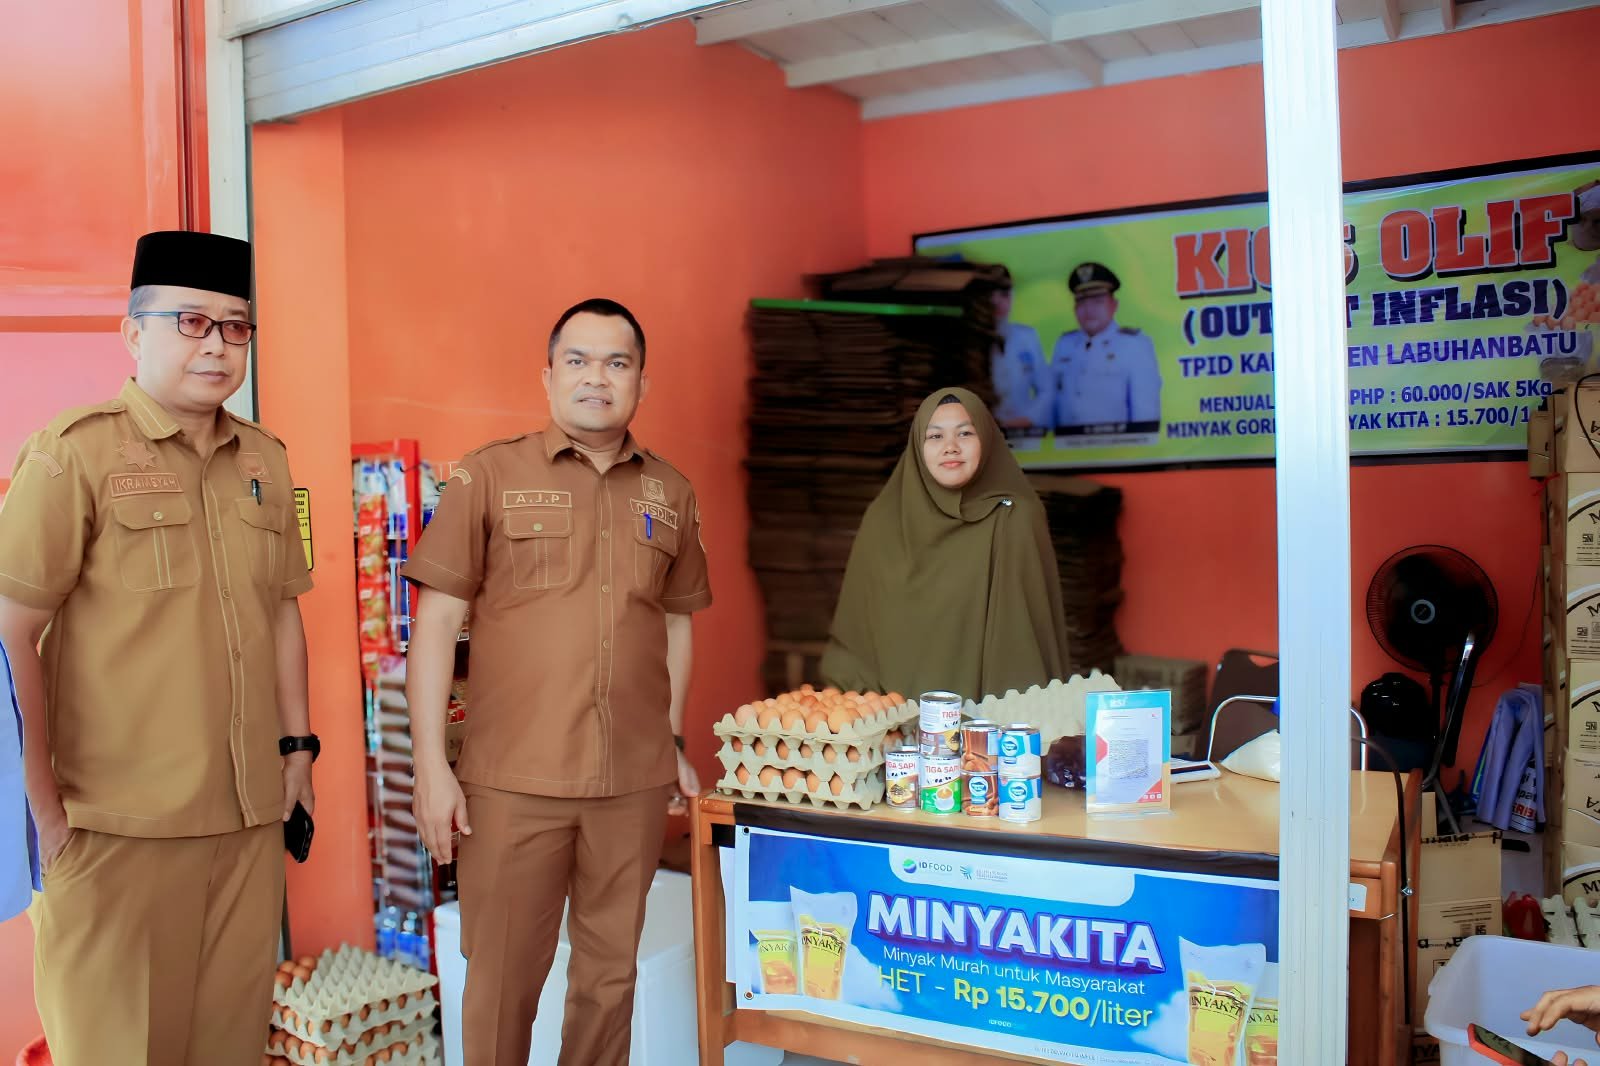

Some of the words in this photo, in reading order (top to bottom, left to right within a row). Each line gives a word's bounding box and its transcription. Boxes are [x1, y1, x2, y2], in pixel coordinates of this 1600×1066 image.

[1379, 192, 1578, 280] OLIF
[1372, 278, 1568, 326] INFLASI)
[1179, 355, 1232, 377] TPID
[1387, 331, 1577, 365] LABUHANBATU
[1200, 394, 1275, 413] MENJUAL
[1401, 381, 1510, 405] 60.000/SAK
[1166, 420, 1232, 438] MINYAK
[1387, 411, 1430, 429] KITA
[867, 892, 1165, 971] MINYAKITA
[883, 946, 936, 968] Minyak
[941, 955, 990, 976] Murah
[994, 965, 1040, 984] untuk
[1045, 970, 1146, 995] Masyarakat
[879, 966, 926, 994] HET
[954, 977, 989, 1009] Rp
[998, 985, 1152, 1028] 15.700/liter
